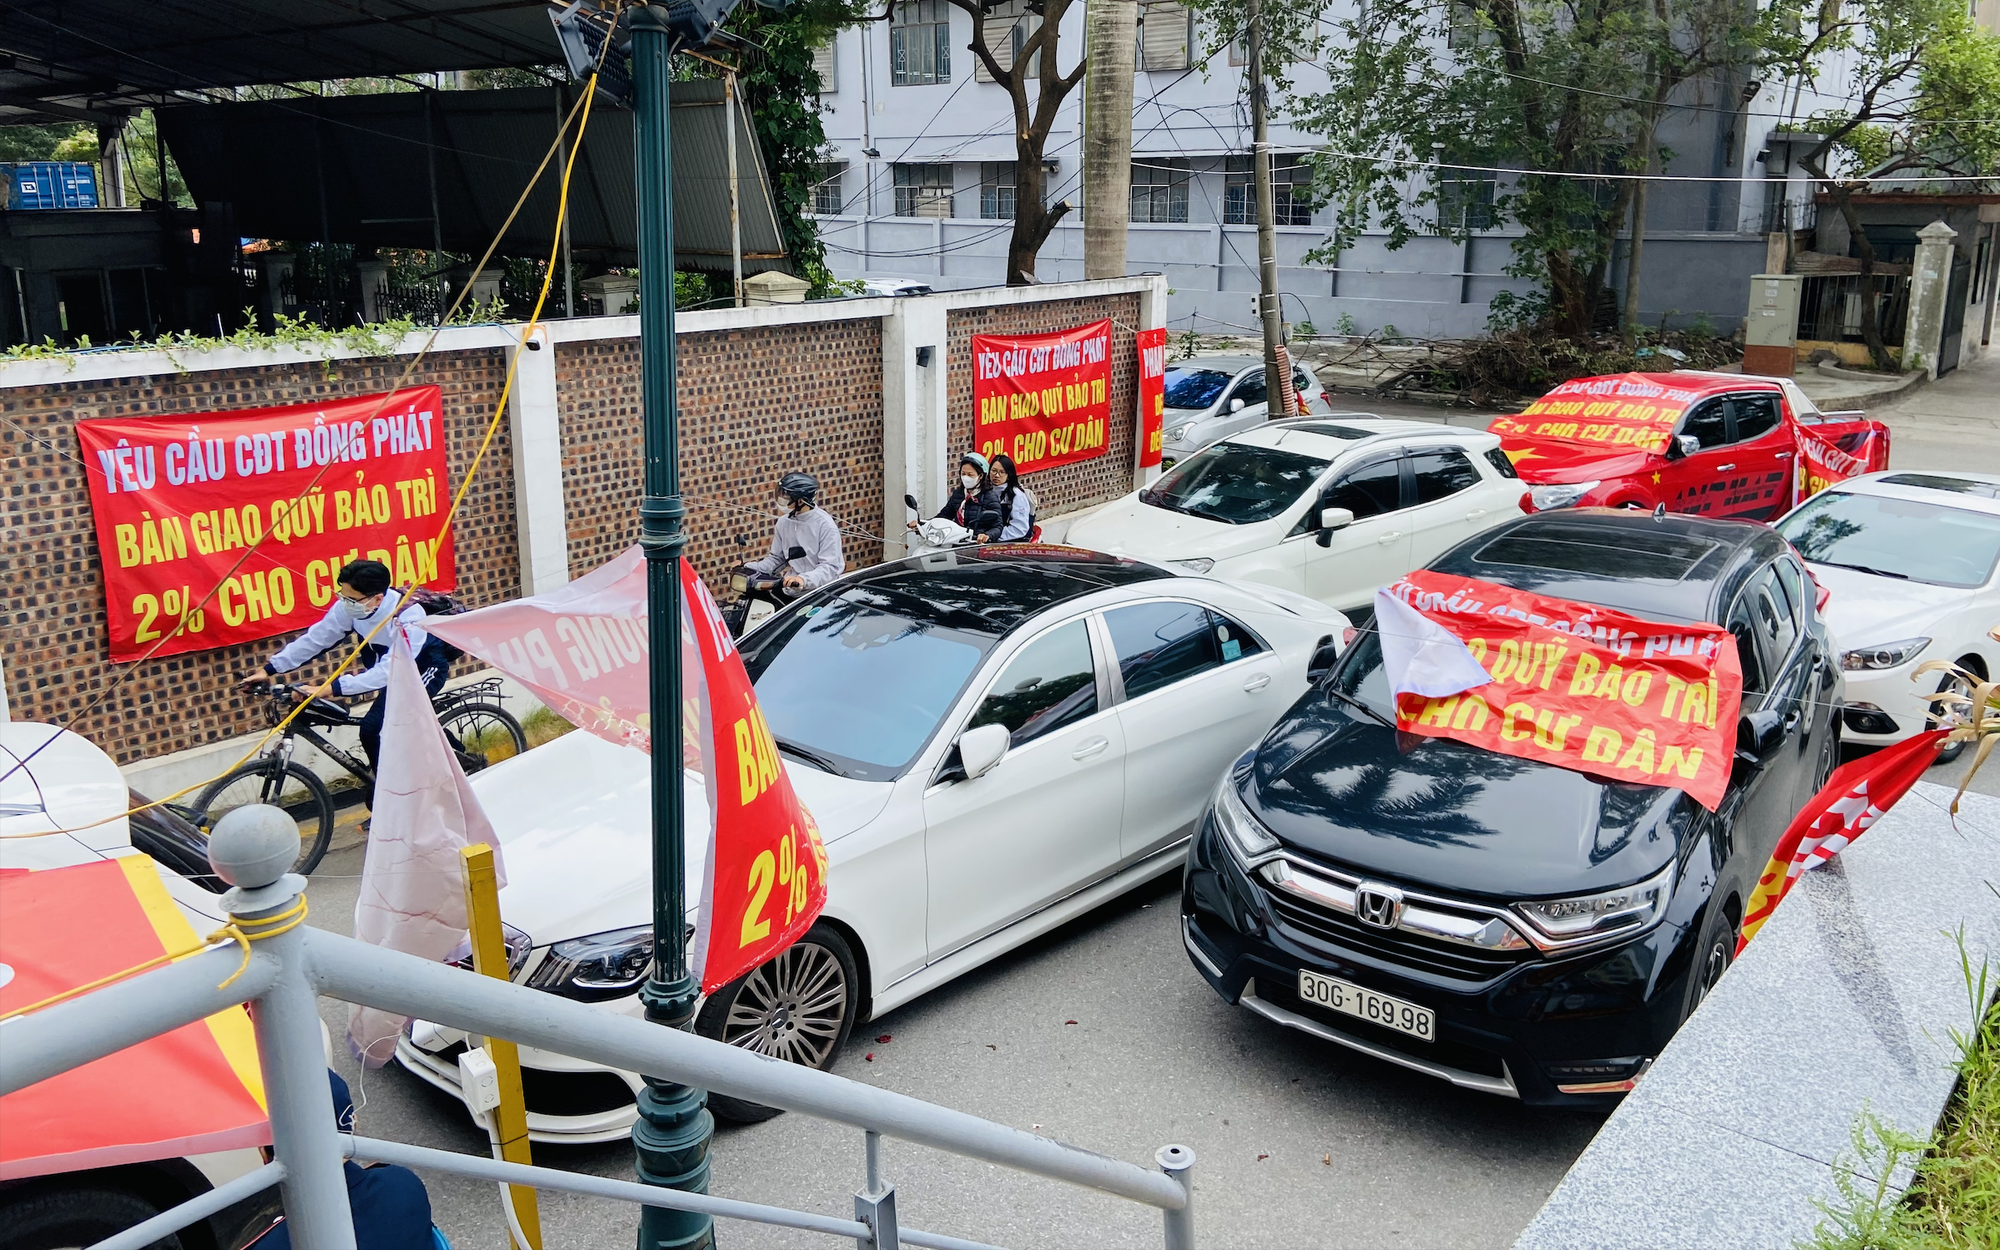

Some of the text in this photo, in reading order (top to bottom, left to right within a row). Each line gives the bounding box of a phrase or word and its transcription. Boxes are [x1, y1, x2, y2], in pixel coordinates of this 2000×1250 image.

[1002, 341, 1028, 378] CẦU
[1082, 331, 1107, 364] PHÁT
[980, 372, 1107, 426] BÀN GIAO QUỸ BẢO TRÌ
[1546, 401, 1584, 415] GIAO
[1583, 400, 1621, 418] QUỸ
[1616, 400, 1657, 421] BẢO
[97, 405, 433, 494] YÊU CẦU CĐT ĐỒNG PHÁT
[1013, 430, 1046, 465] CHO
[1050, 422, 1076, 457] CƯ
[1073, 414, 1104, 453] DÂN
[115, 468, 437, 568] BÀN GIAO QUỸ BẢO TRÌ
[132, 585, 205, 645] 2%
[218, 567, 295, 627] CHO
[1492, 636, 1568, 690] QUỸ
[1661, 668, 1719, 729] TRÌ
[1500, 702, 1583, 751] CƯ
[1581, 728, 1704, 780] DÂN
[738, 823, 808, 950] 2%
[1303, 976, 1429, 1036] 30G-169.98
